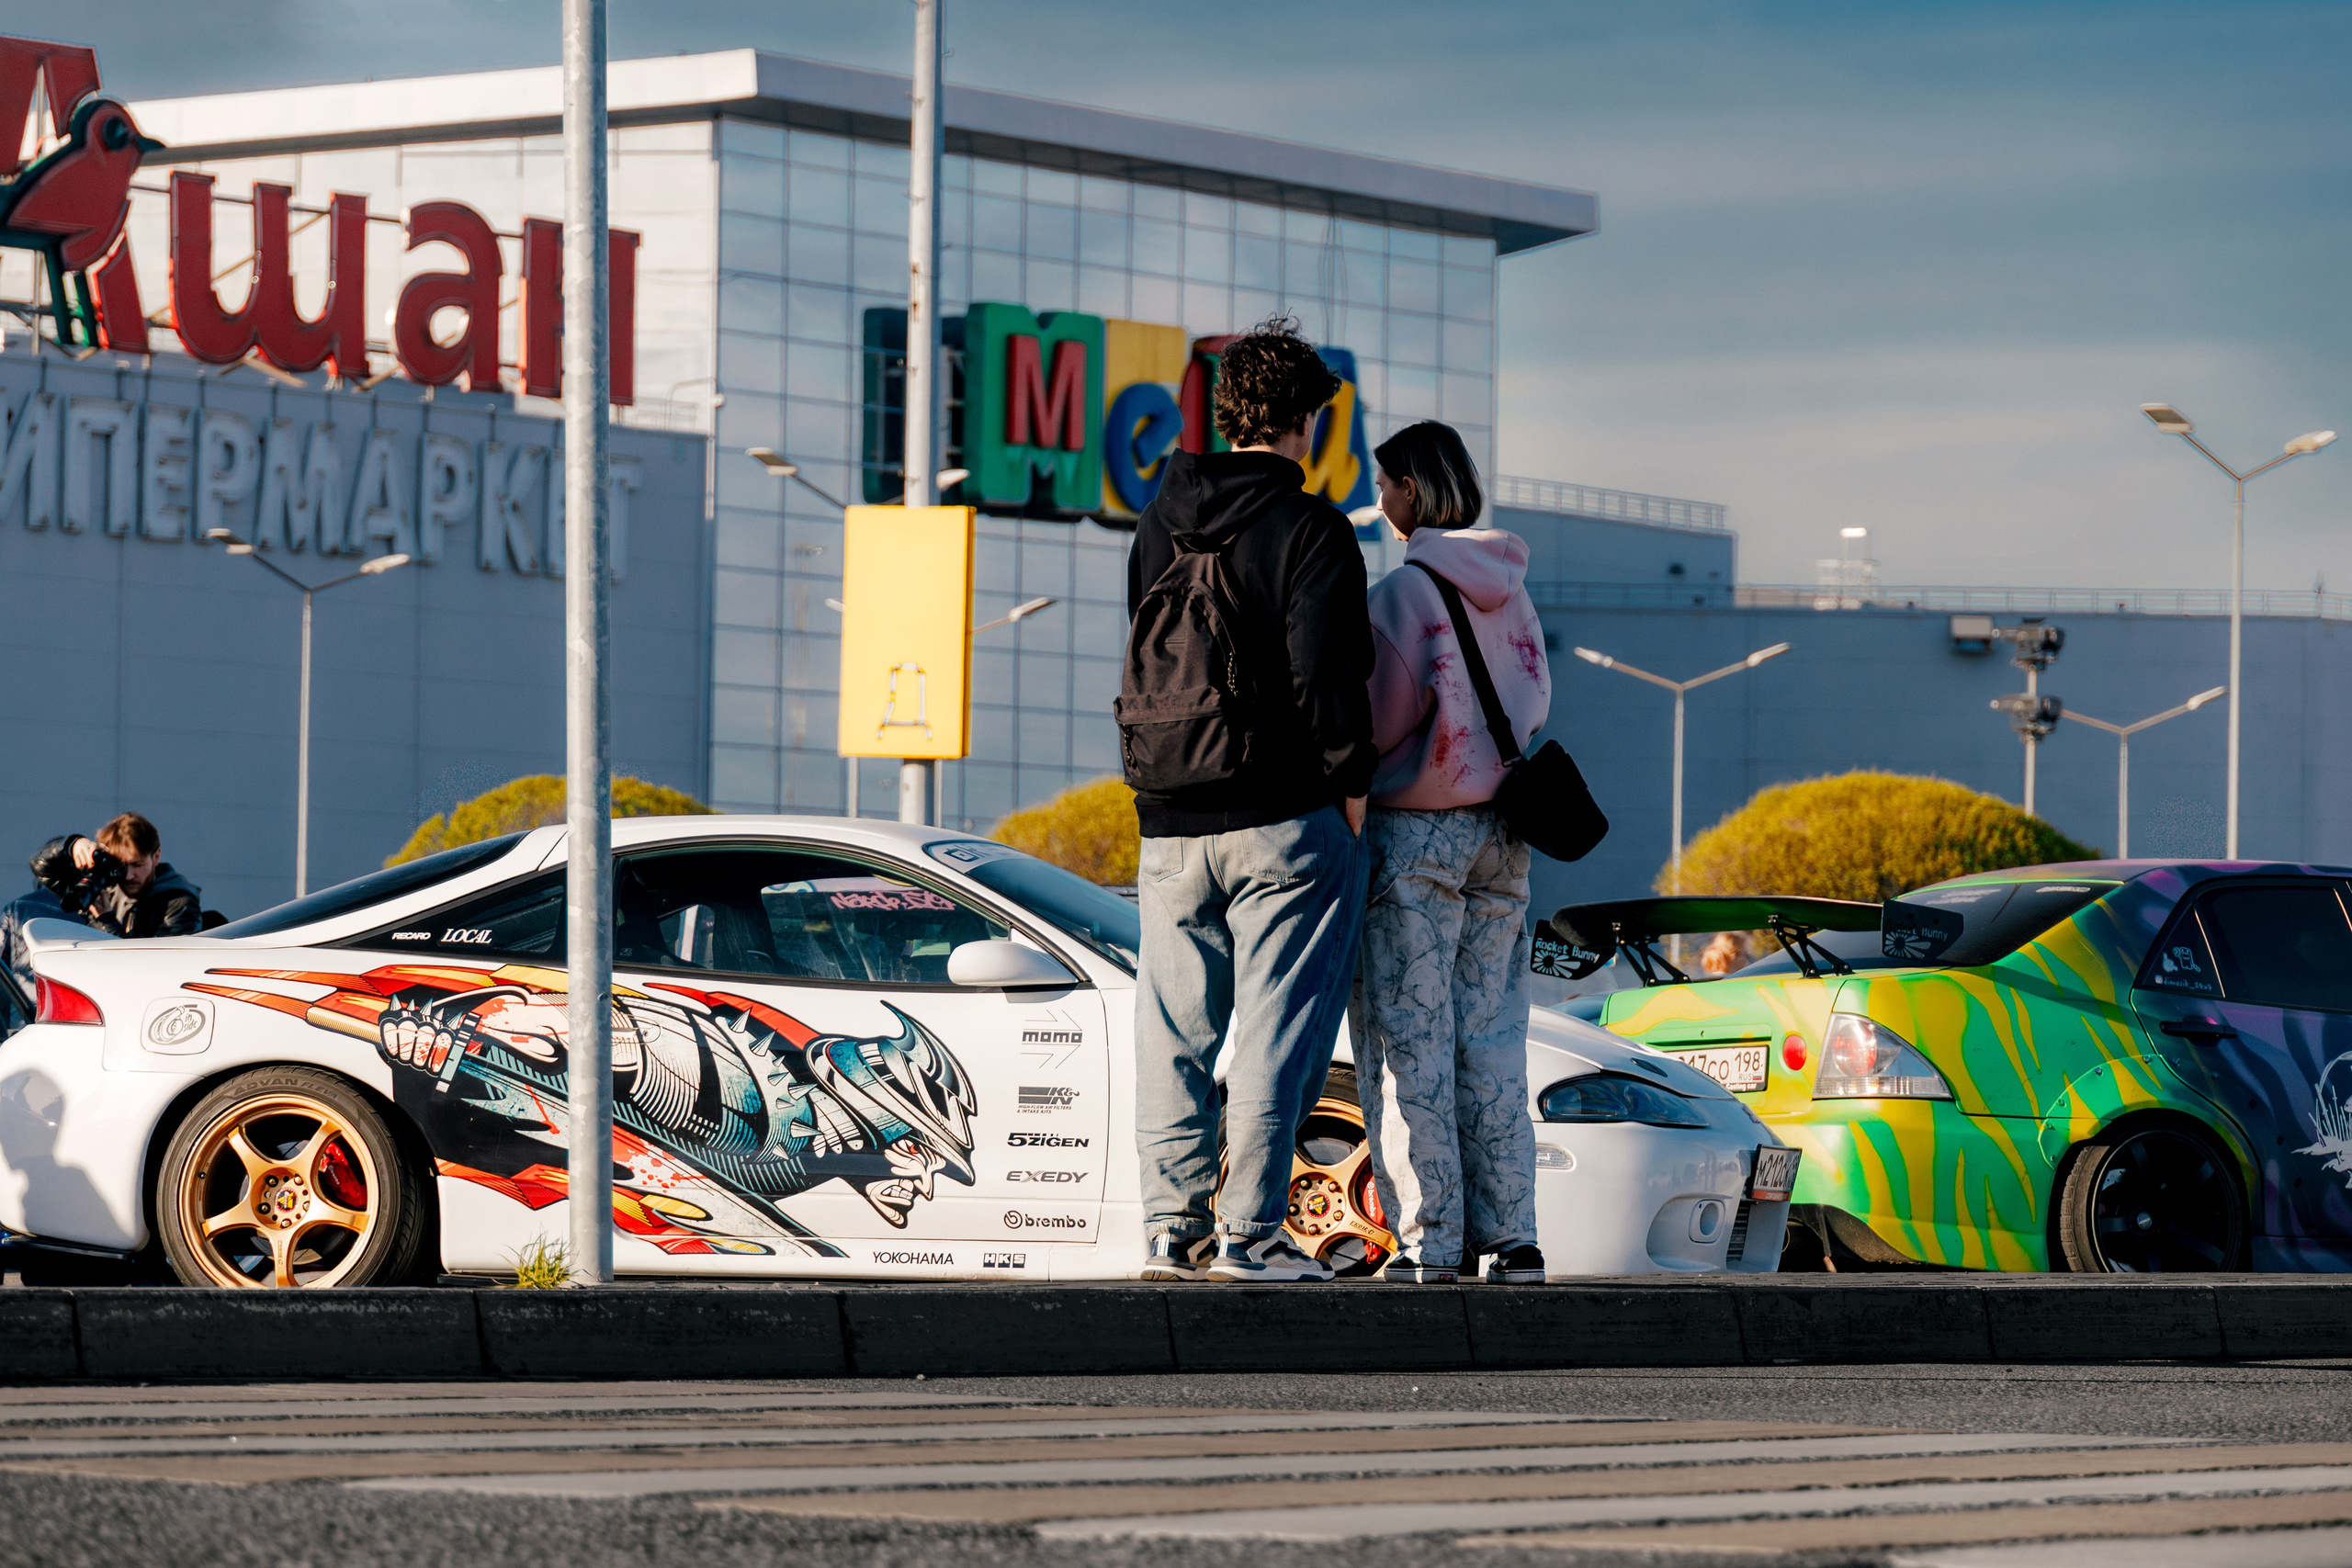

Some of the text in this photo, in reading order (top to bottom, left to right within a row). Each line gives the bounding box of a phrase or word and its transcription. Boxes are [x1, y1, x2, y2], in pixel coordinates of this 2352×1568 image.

[391, 928, 492, 944] RECARO LOCAL
[1535, 937, 1600, 964] Rocket Bunny
[1735, 1050, 1761, 1073] 198
[1738, 1073, 1752, 1081] RUS
[233, 1077, 299, 1096] ADVAN
[1006, 1170, 1089, 1183] EXEDY
[1367, 1189, 1376, 1217] brembo
[1024, 1213, 1087, 1229] brembo
[873, 1251, 955, 1266] YOKOHAMA
[982, 1252, 1027, 1269] HKS
